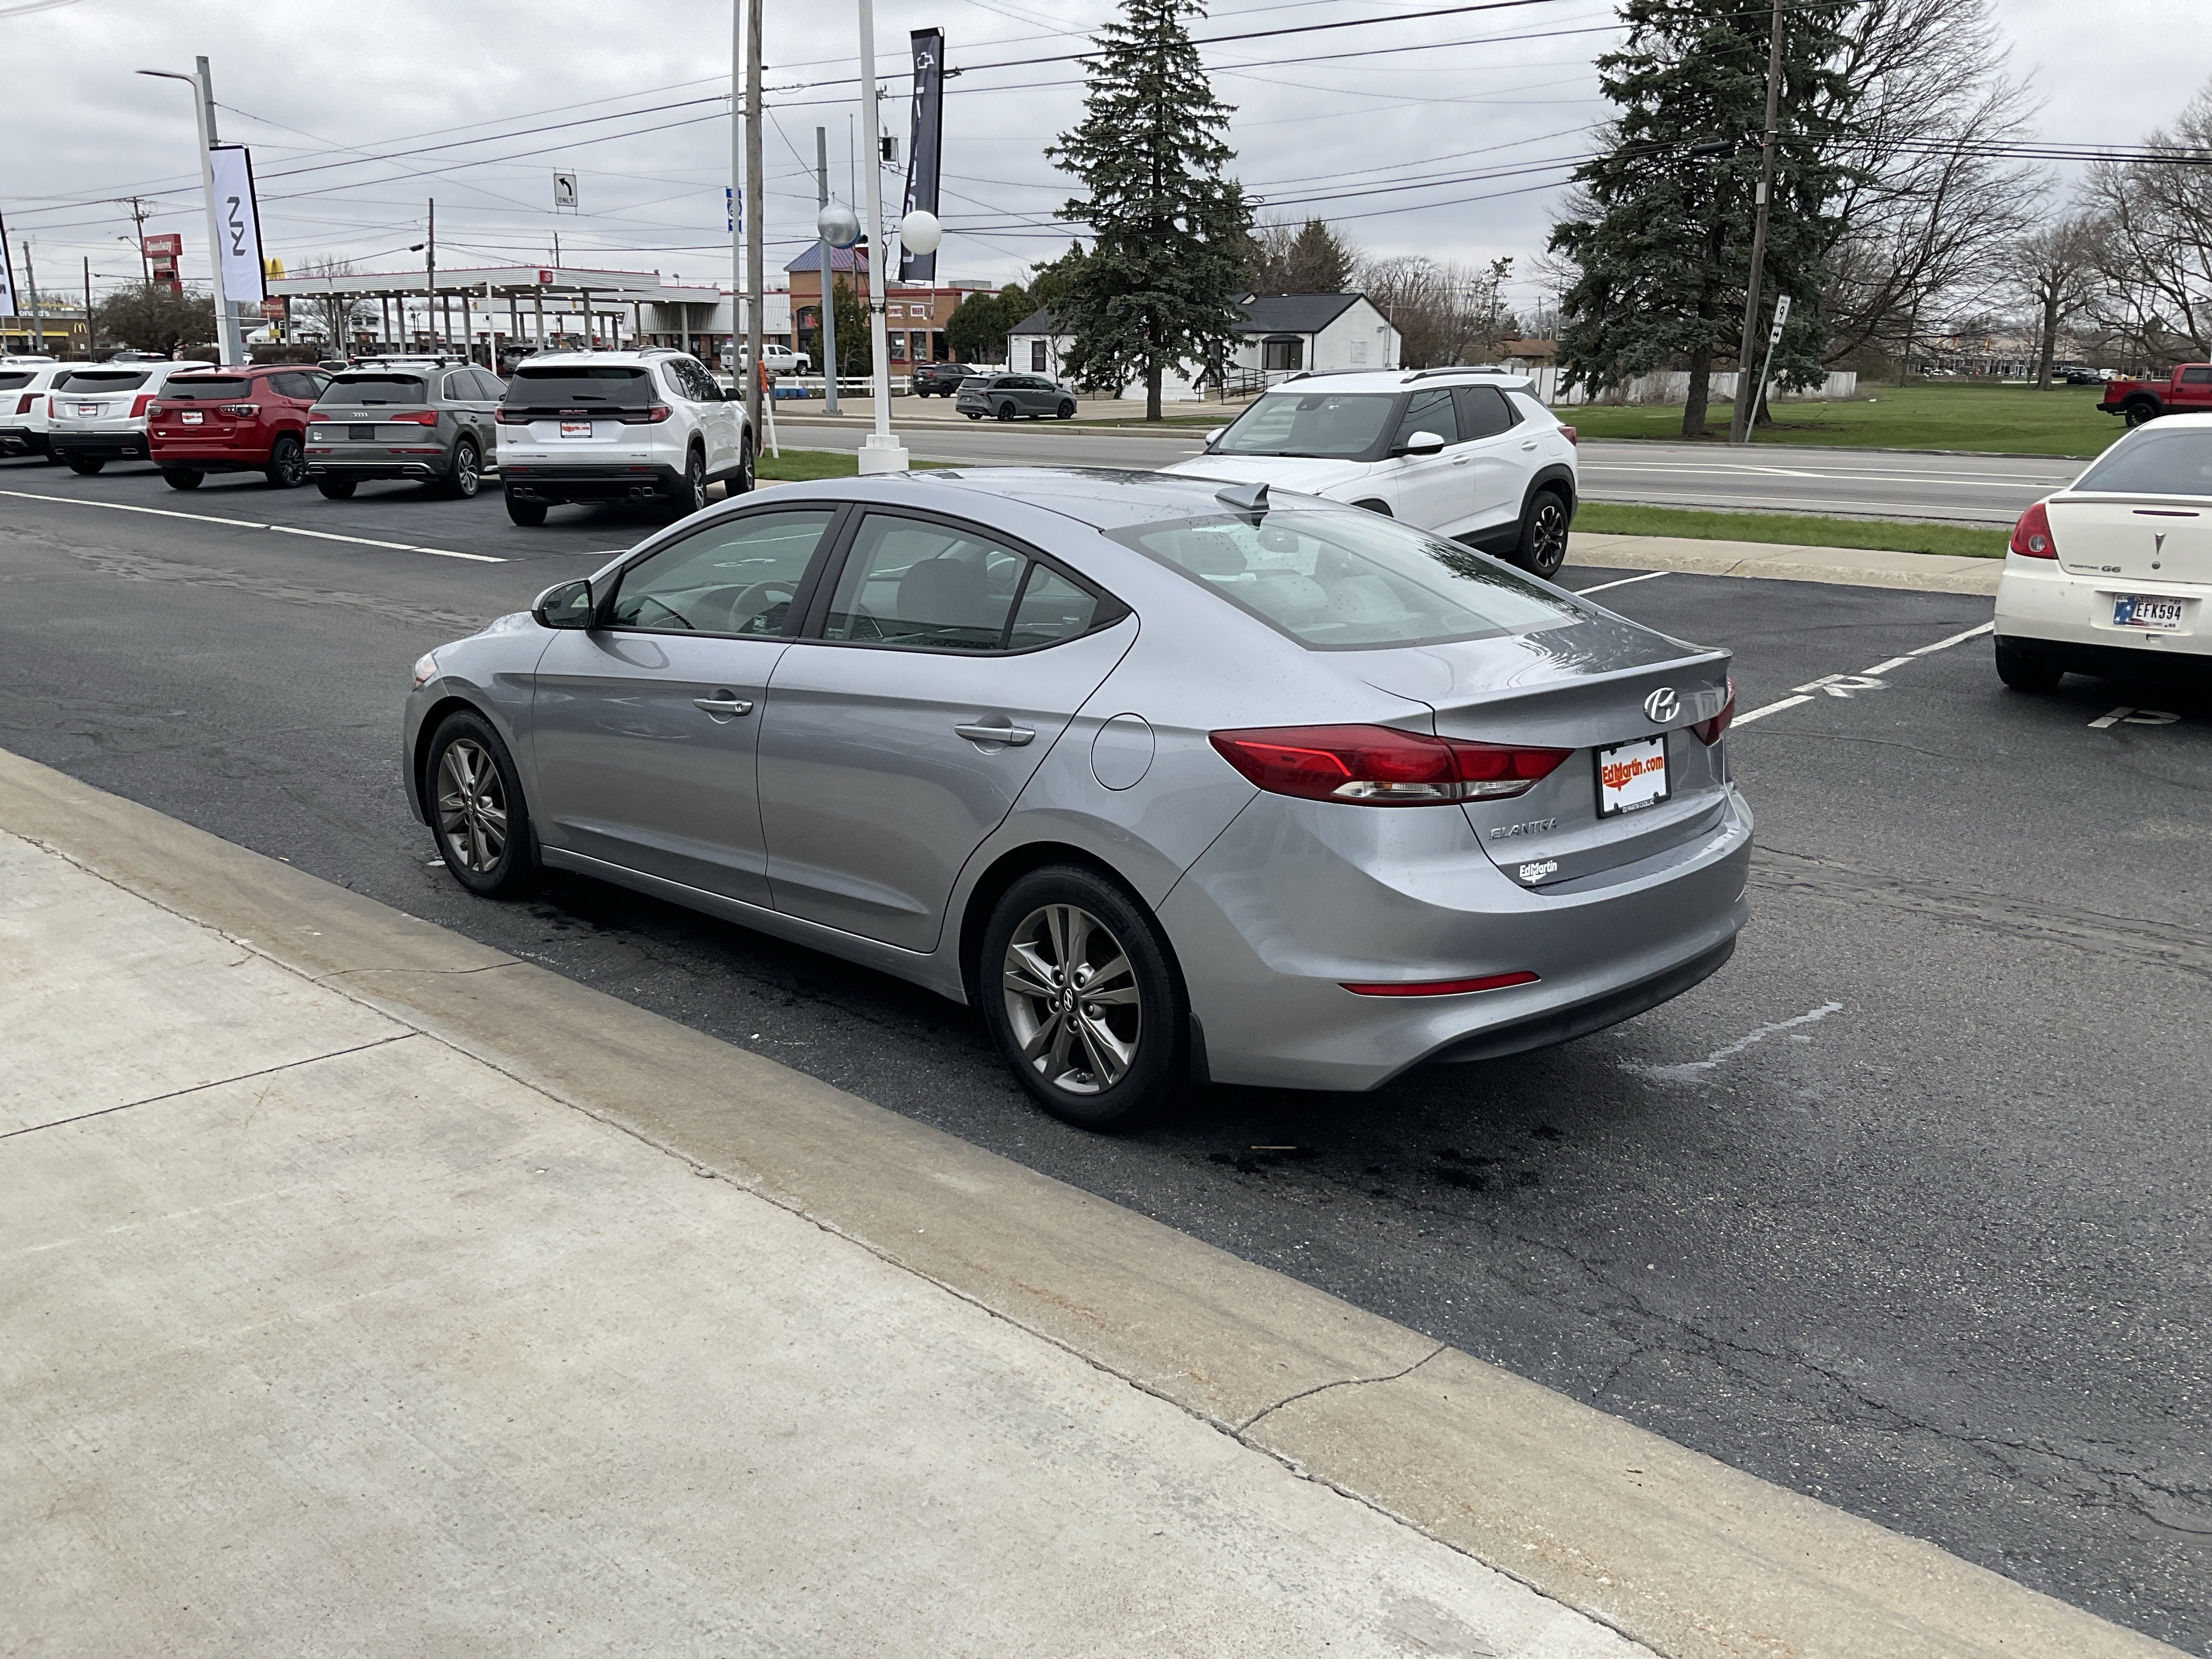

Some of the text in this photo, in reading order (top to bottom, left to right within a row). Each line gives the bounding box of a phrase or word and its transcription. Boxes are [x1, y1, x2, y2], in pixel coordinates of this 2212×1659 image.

[146, 240, 172, 254] Speedway
[1778, 306, 1785, 320] 9
[2136, 603, 2182, 620] EFK594
[1601, 755, 1664, 785] EdMartin.com
[1489, 817, 1558, 840] ELANTRA
[1519, 860, 1558, 878] EdMartin
